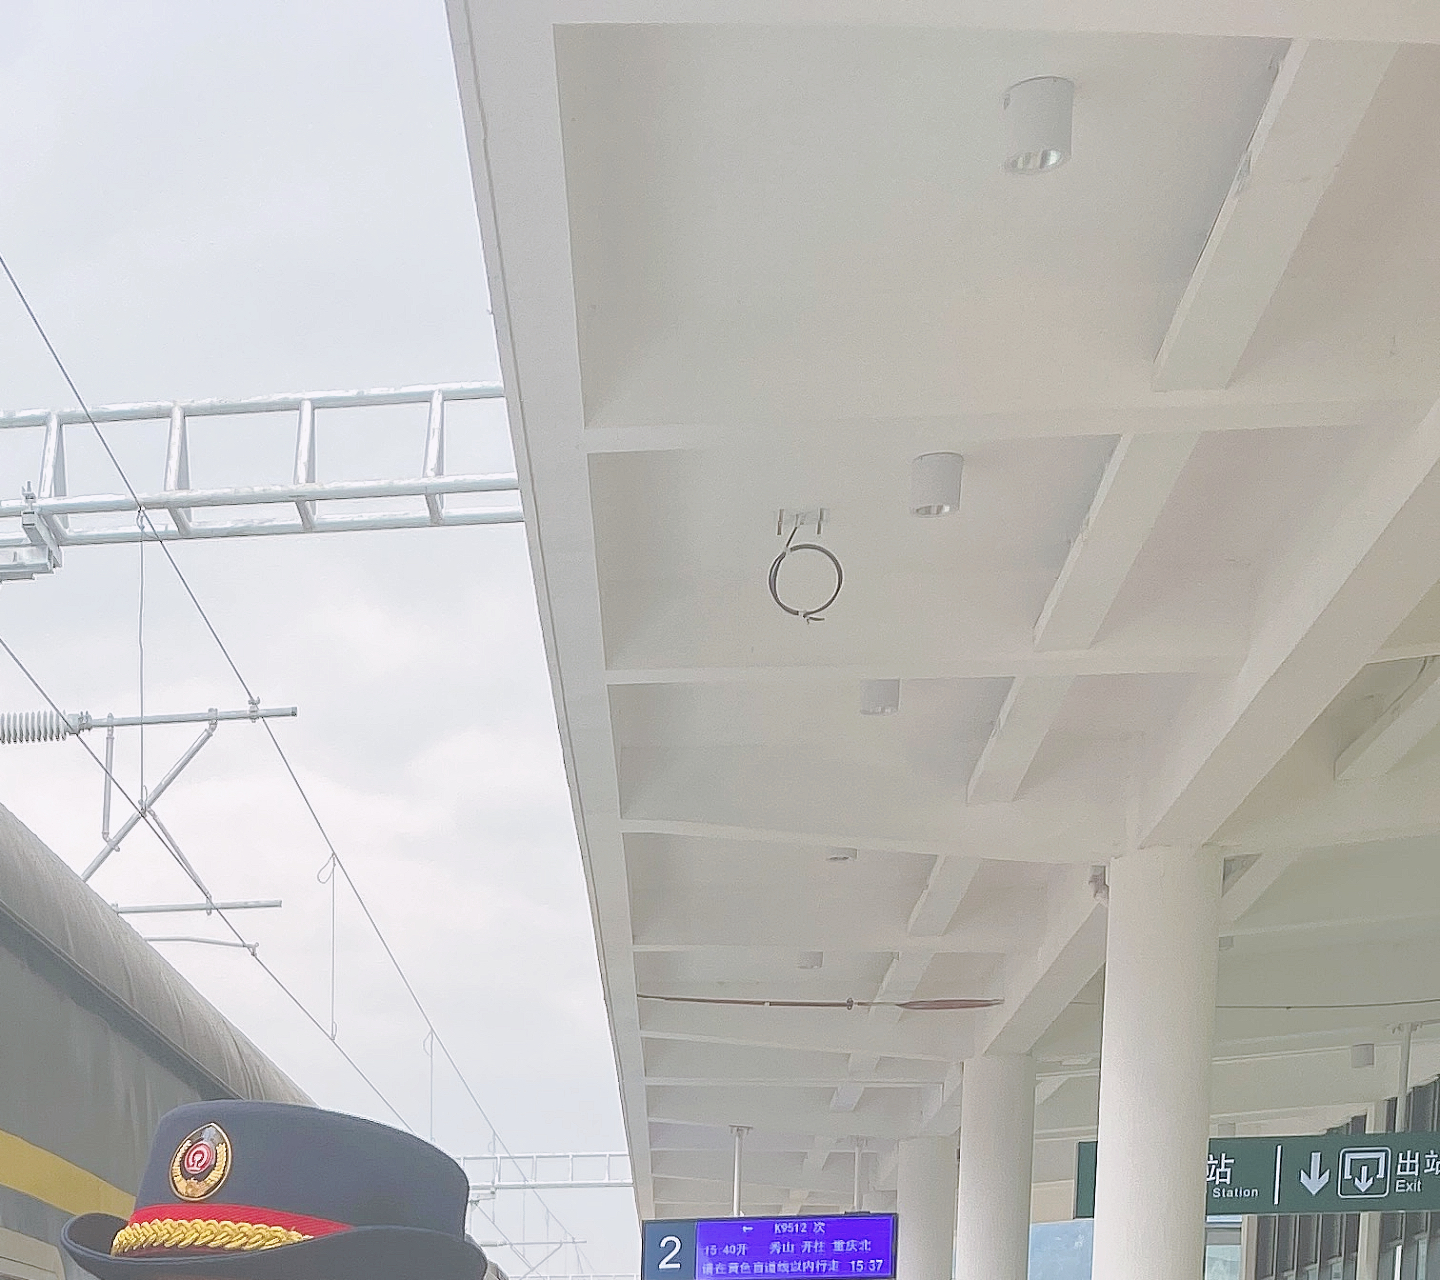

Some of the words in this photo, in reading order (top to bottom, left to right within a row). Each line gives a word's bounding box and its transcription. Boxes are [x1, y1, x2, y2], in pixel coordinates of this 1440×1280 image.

[1212, 1186, 1259, 1199] Station
[1395, 1179, 1422, 1193] Exit
[812, 1221, 826, 1234] 次
[658, 1235, 682, 1269] 2
[768, 1241, 795, 1255] 秀山
[830, 1238, 872, 1253] 重庆北
